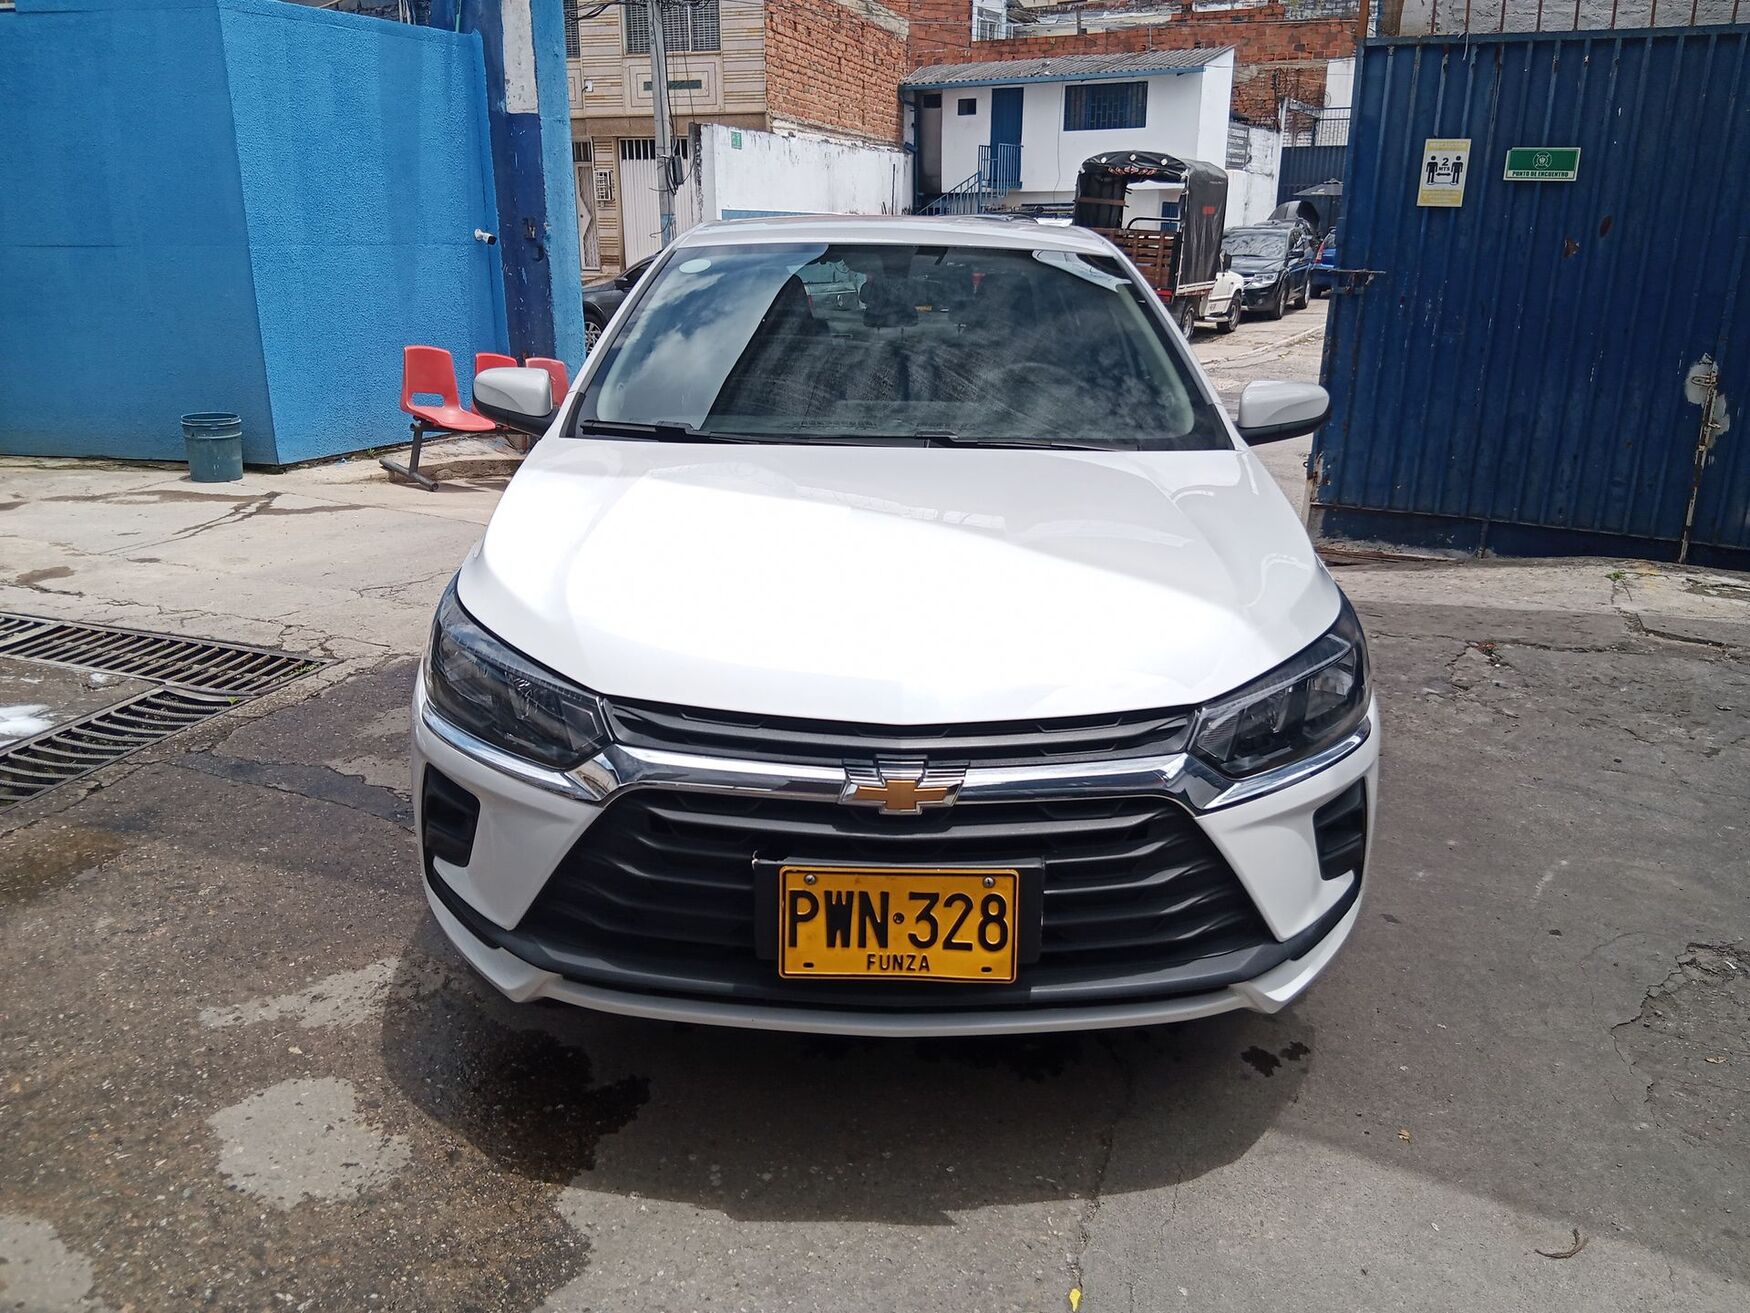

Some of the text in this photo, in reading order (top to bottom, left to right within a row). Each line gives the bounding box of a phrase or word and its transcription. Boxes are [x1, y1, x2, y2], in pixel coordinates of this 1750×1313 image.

[1442, 157, 1449, 166] 2
[1538, 170, 1569, 178] ENCUENTRO
[866, 953, 930, 972] FUNZA
